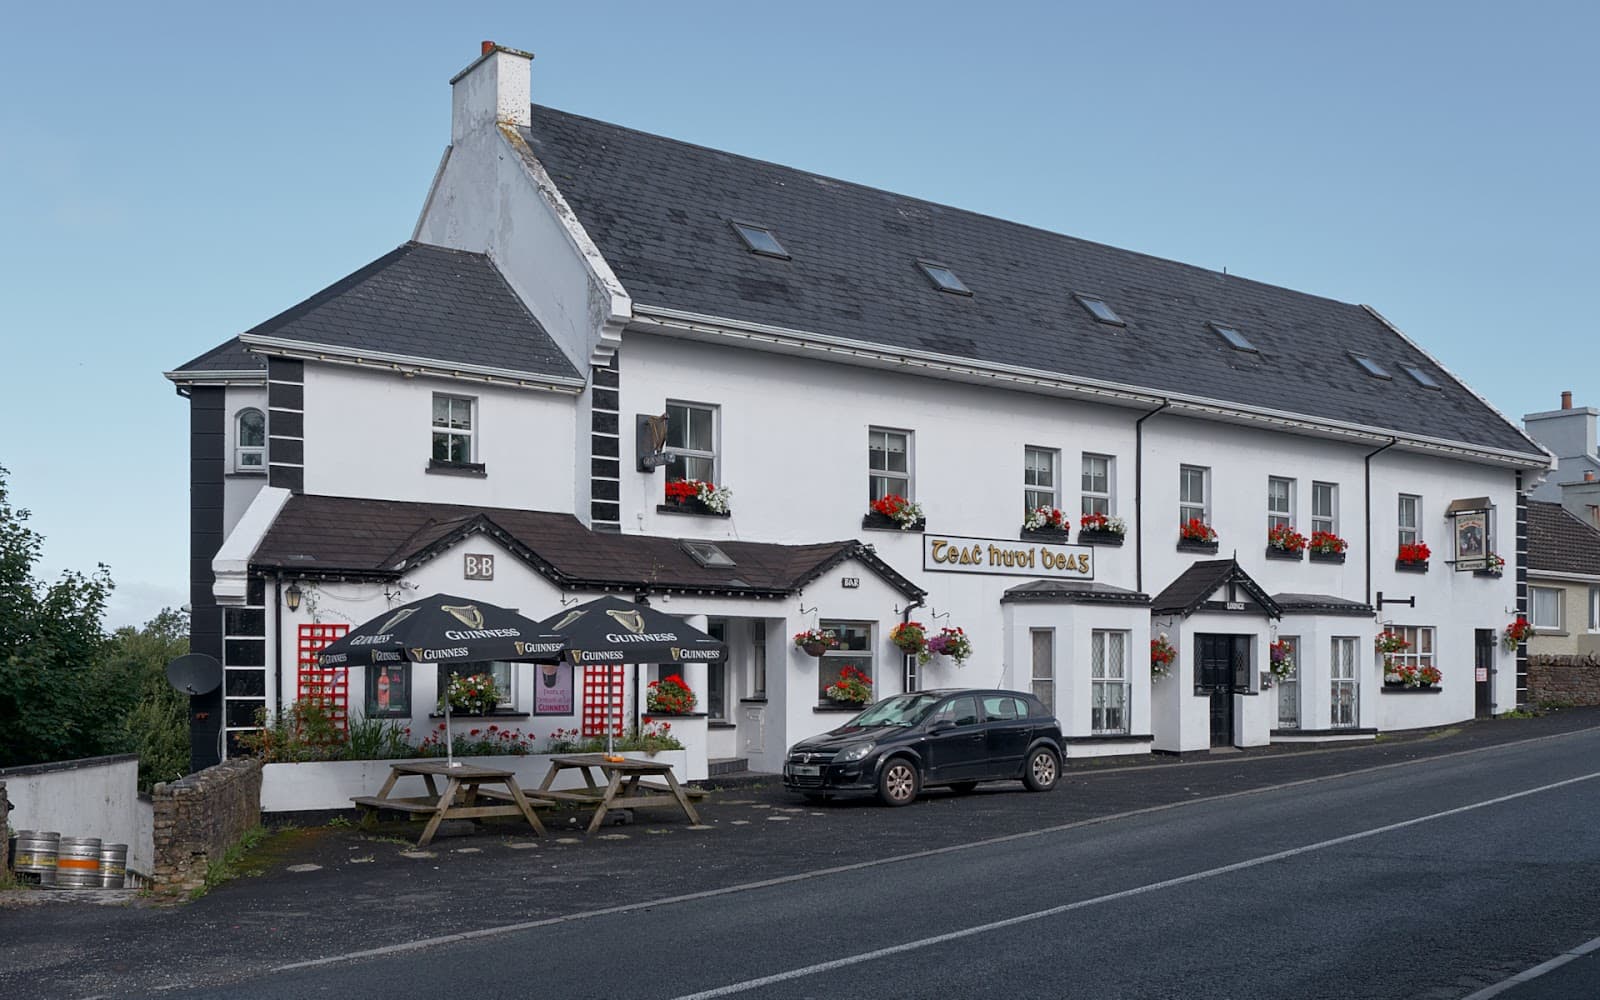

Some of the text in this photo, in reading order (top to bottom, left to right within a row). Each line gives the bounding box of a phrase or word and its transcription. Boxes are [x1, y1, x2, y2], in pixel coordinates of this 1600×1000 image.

[445, 628, 521, 641] GUINNESS
[606, 633, 678, 644] GUINNESS
[423, 647, 469, 660] GUINNESS
[582, 650, 623, 660] GUINNESS
[680, 648, 720, 659] GUINNESS
